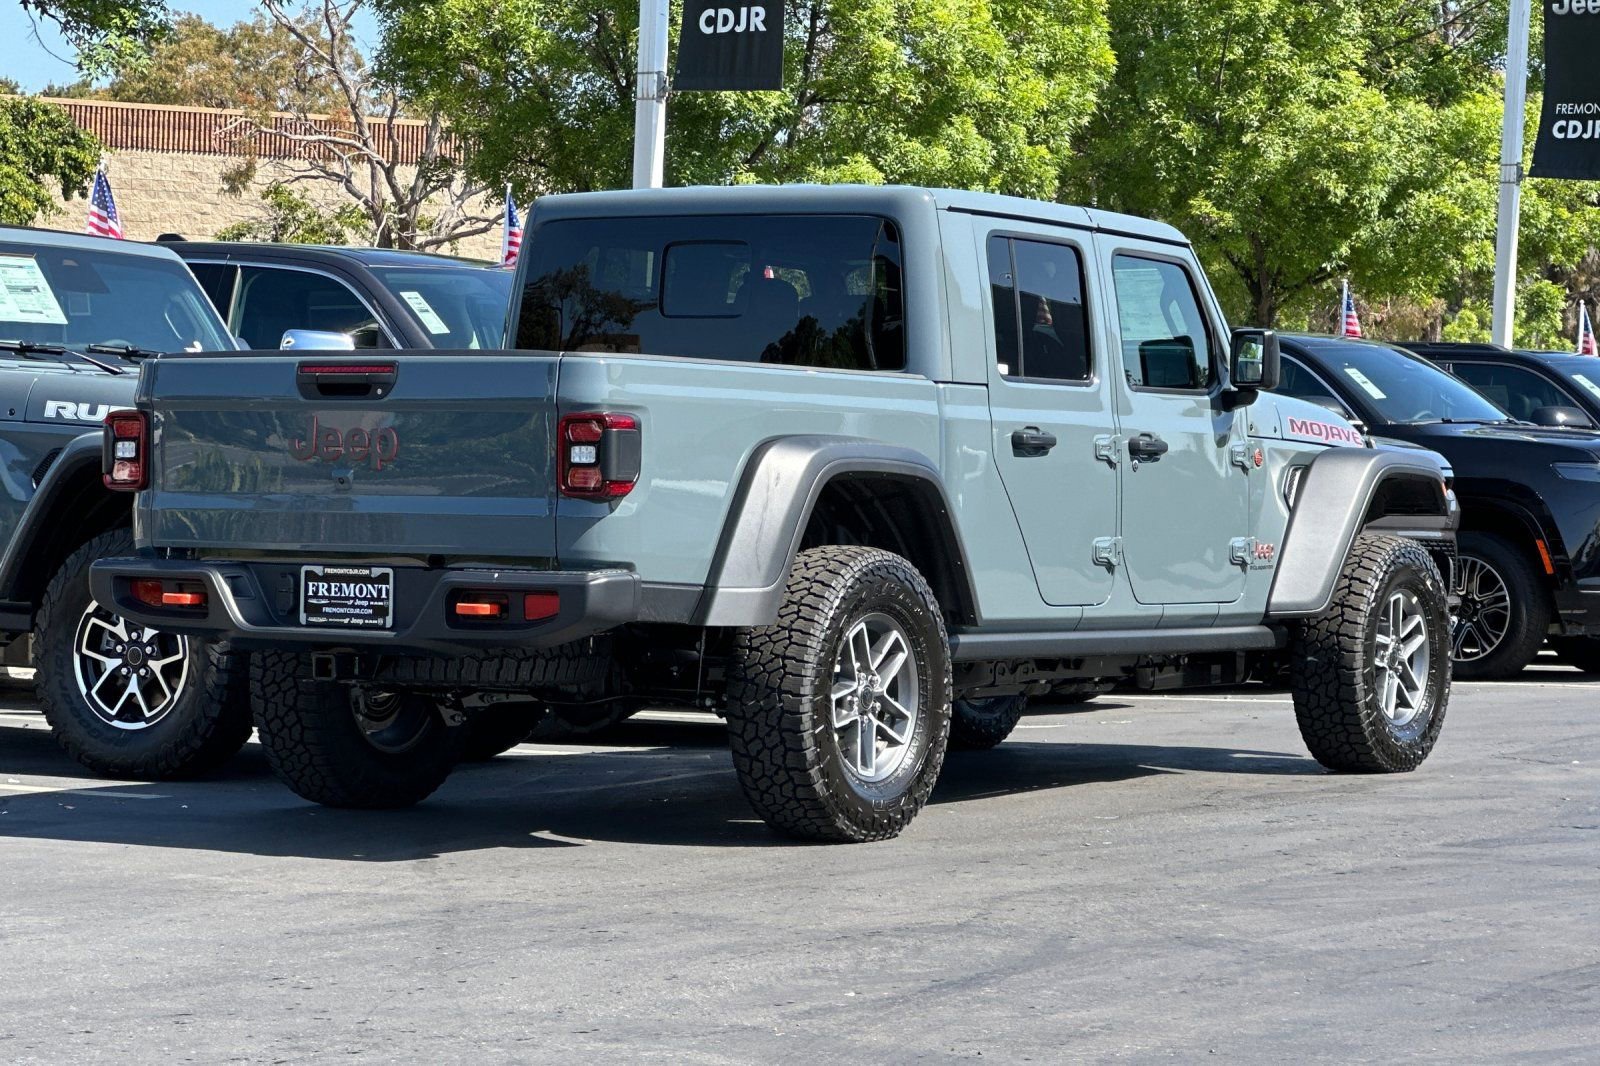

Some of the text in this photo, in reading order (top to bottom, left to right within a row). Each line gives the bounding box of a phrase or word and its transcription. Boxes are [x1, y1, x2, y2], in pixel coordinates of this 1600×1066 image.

[699, 6, 767, 34] CDJR
[288, 415, 398, 471] Jeep
[1288, 417, 1363, 447] MOJAVE
[307, 582, 389, 598] FREMONT
